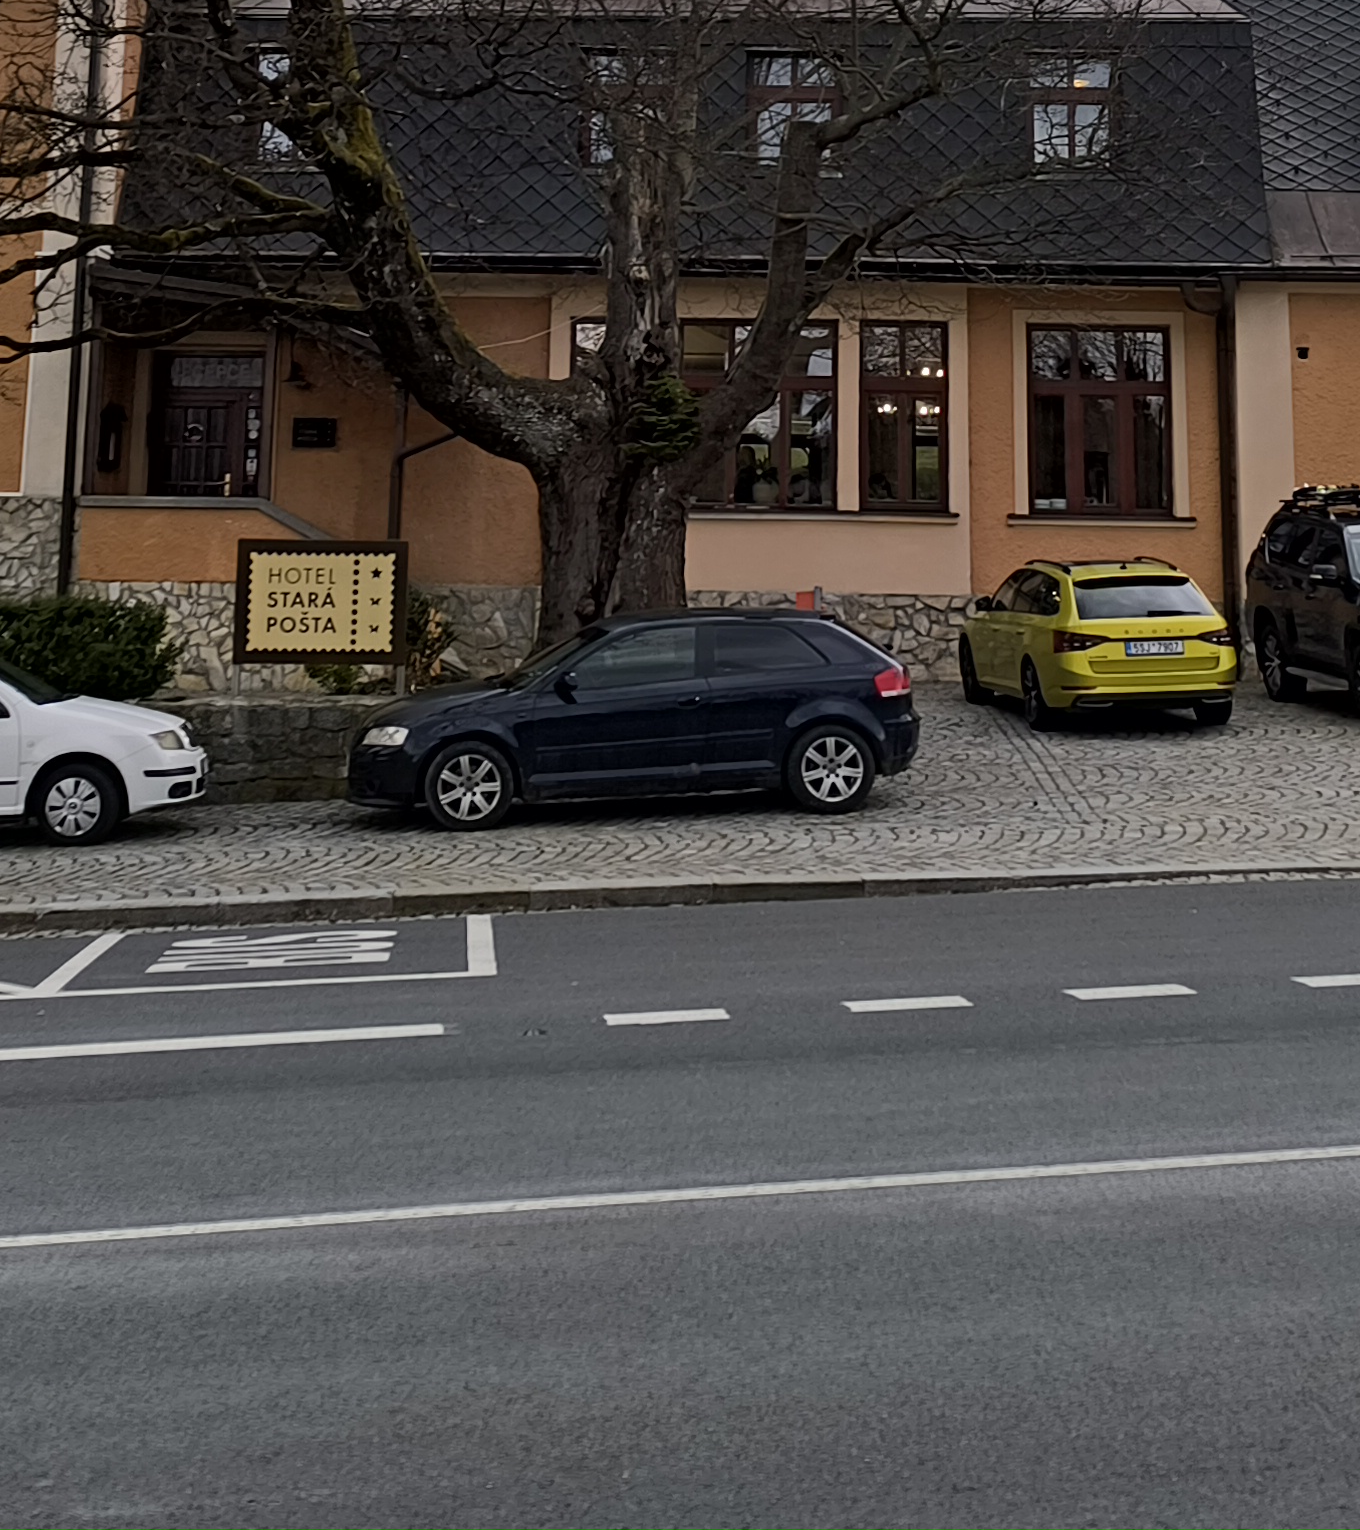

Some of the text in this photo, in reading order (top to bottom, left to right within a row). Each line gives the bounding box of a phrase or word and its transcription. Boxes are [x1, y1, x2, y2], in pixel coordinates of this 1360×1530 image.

[268, 567, 336, 584] HOTEL
[267, 586, 336, 608] STARÁ
[266, 611, 337, 633] POŠTA
